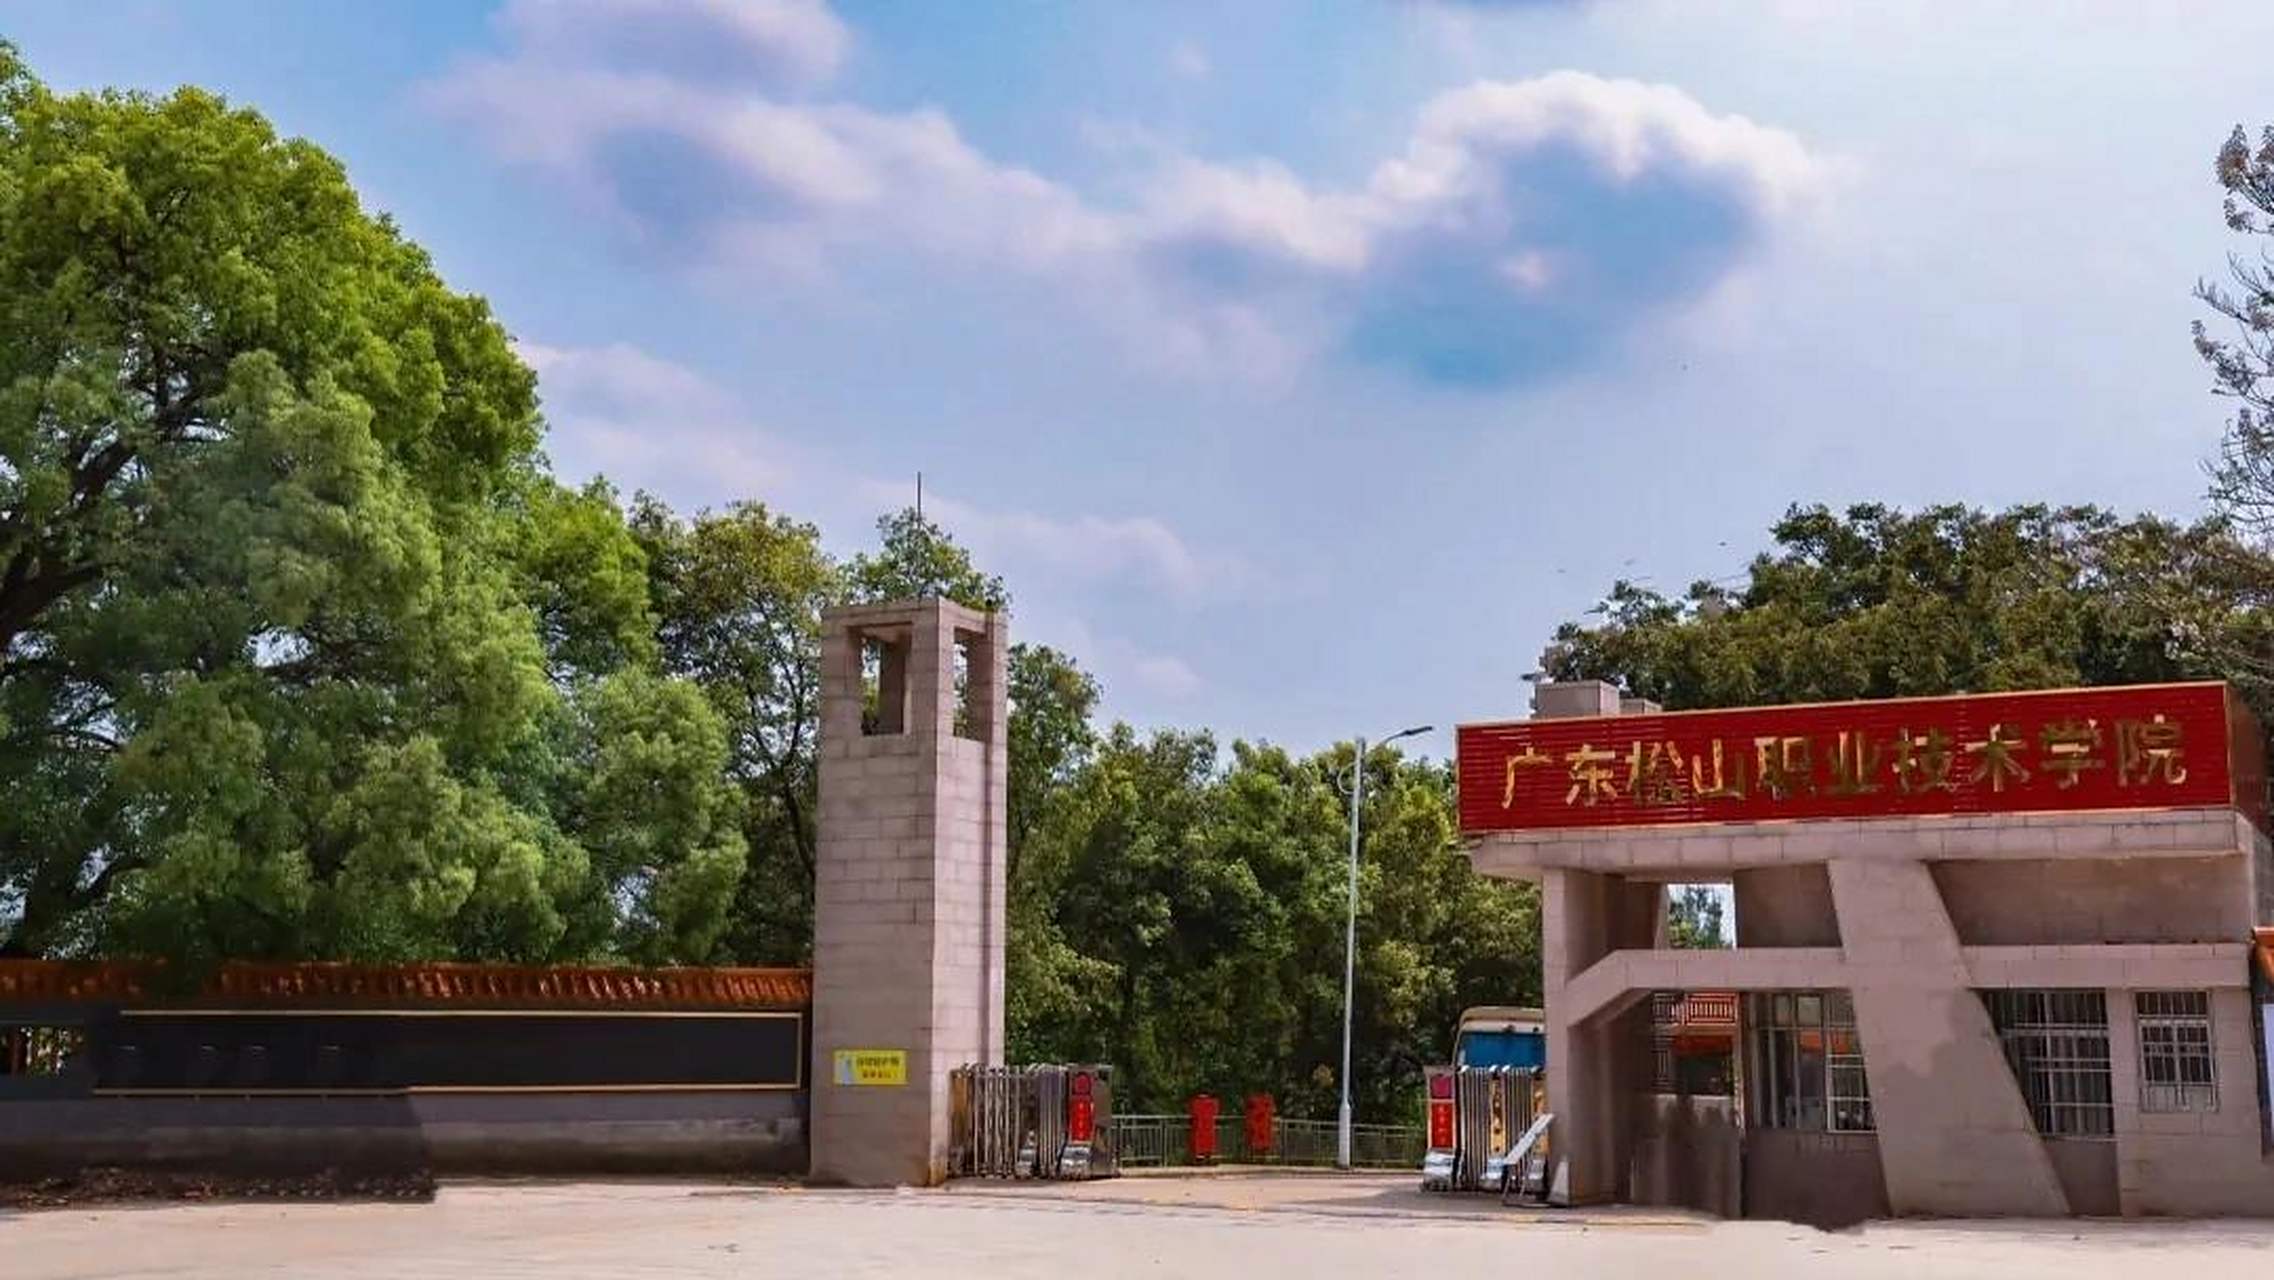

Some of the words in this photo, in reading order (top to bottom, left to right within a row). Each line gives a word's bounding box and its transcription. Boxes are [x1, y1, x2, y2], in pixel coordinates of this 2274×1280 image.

[1503, 714, 2186, 809] 广东松山职业技术学院
